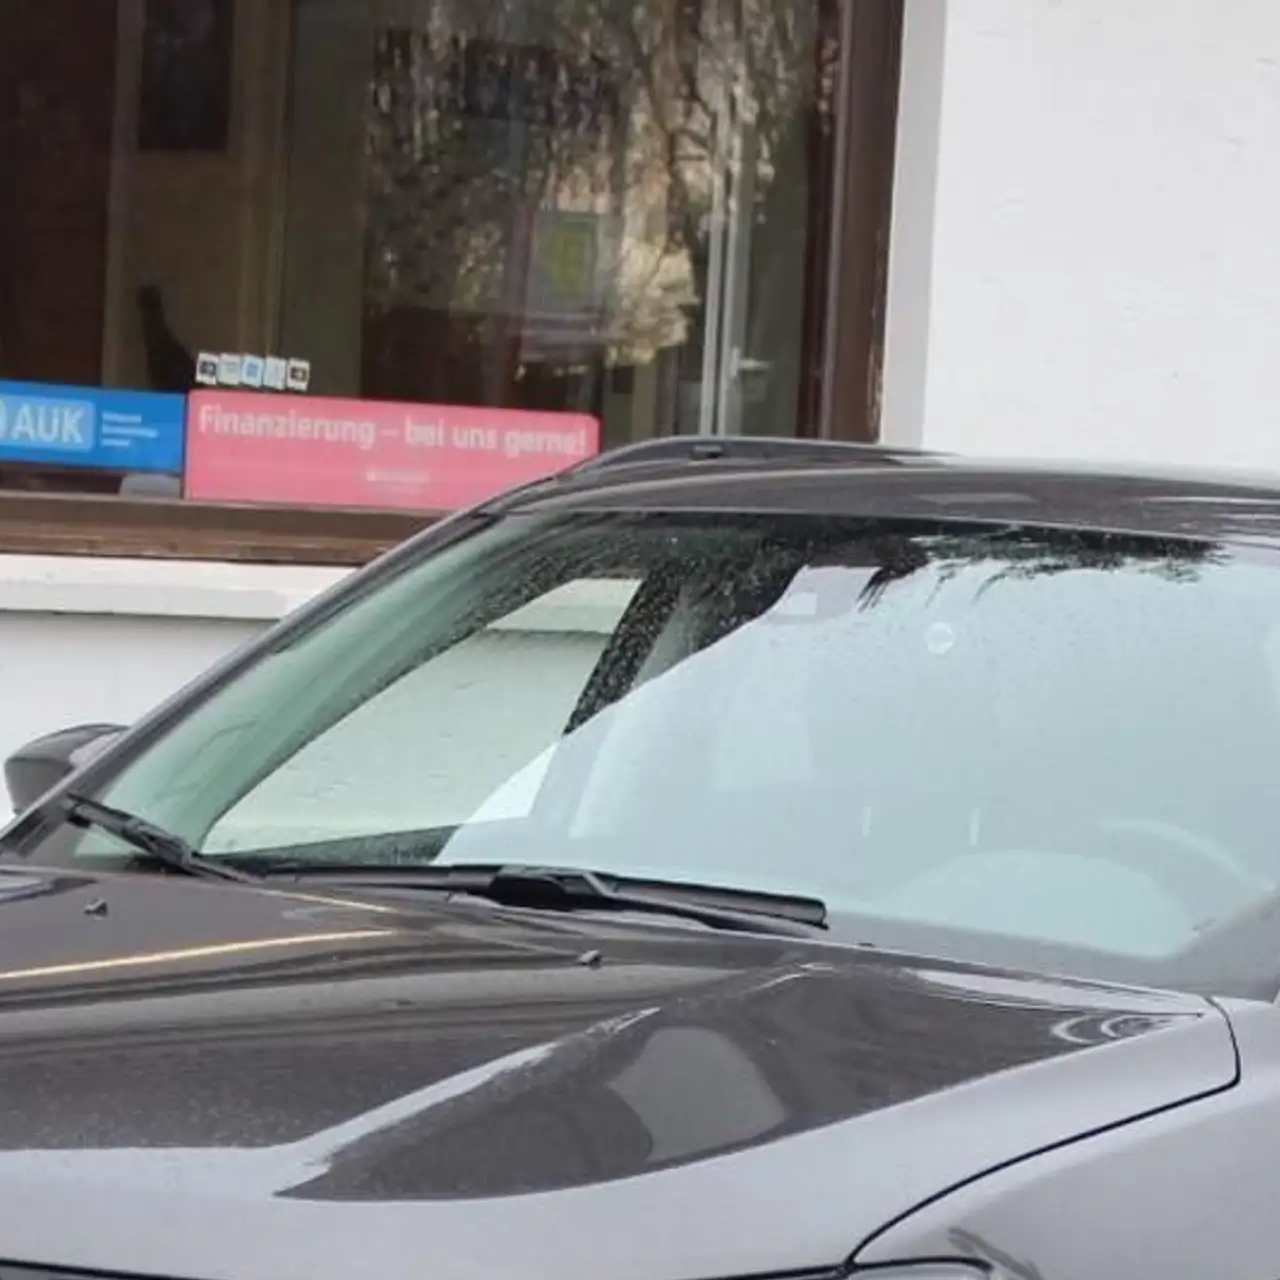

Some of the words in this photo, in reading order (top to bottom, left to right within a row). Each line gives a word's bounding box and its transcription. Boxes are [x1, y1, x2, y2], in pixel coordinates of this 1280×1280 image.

[198, 404, 376, 450] Finanzierung
[404, 417, 445, 446] bei
[452, 428, 497, 451] uns
[504, 427, 587, 459] gerne!
